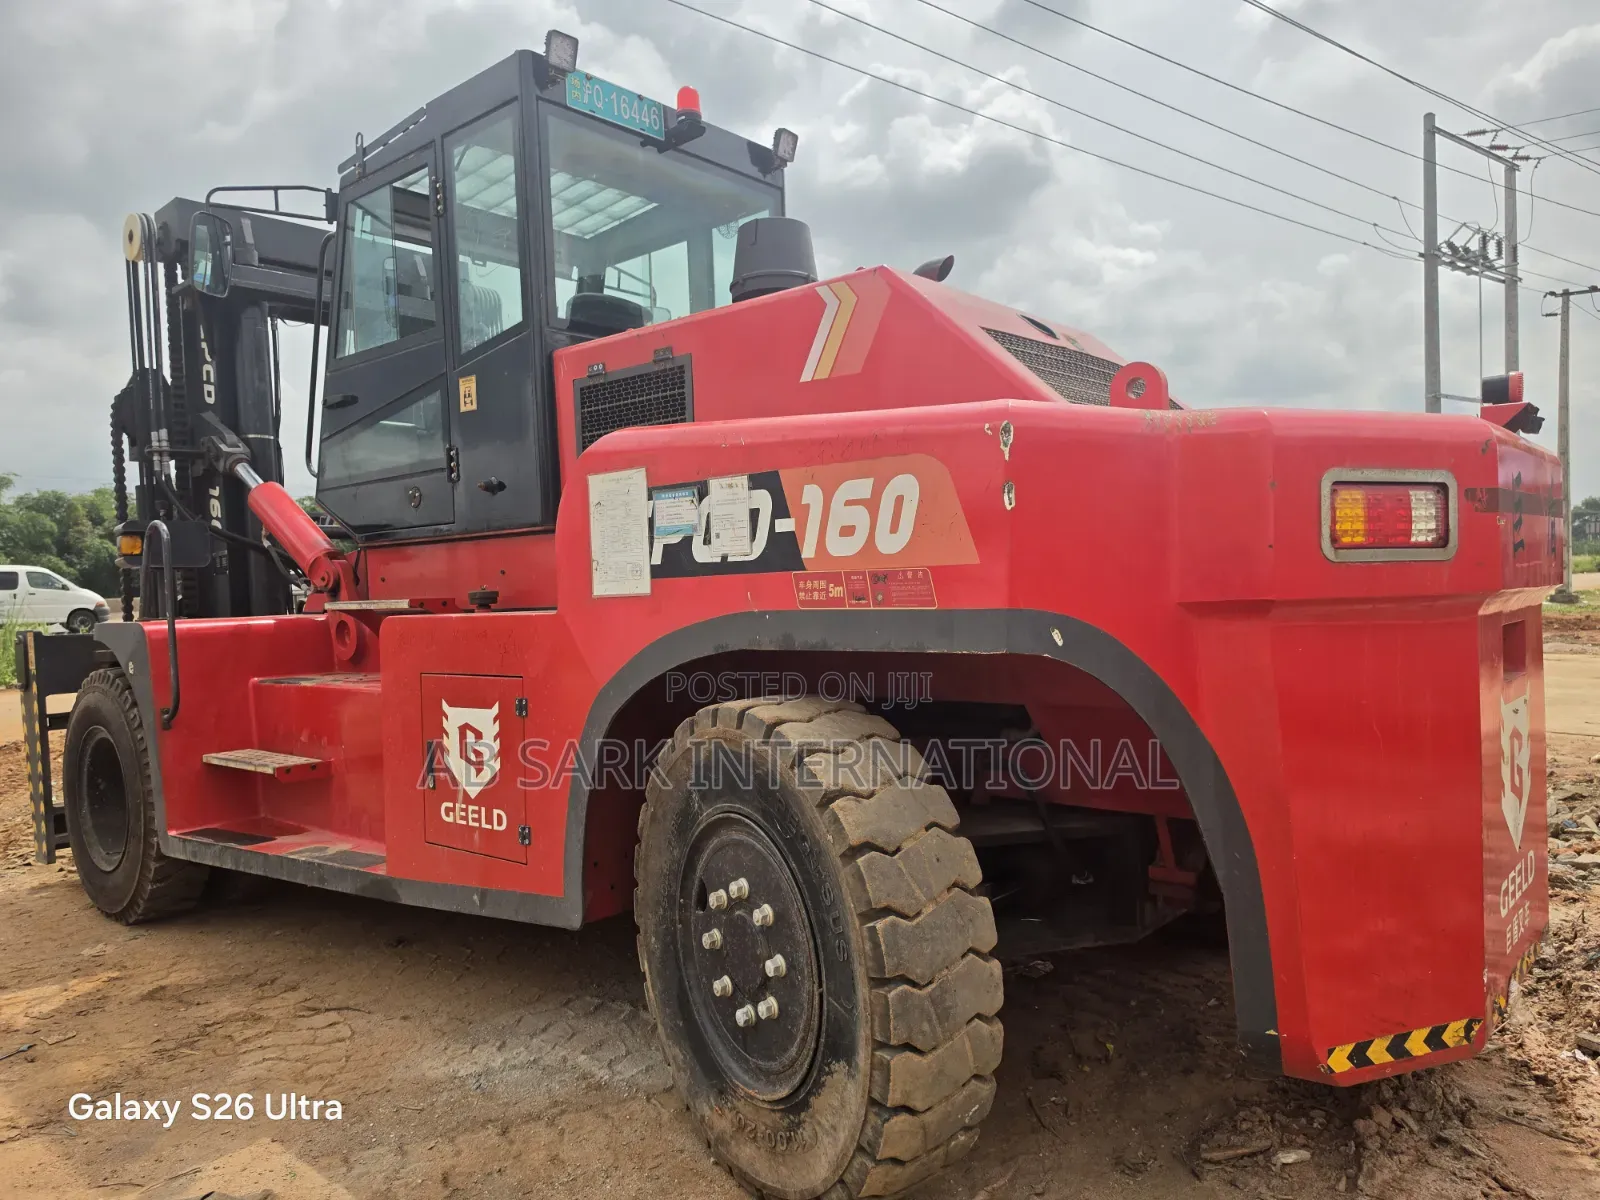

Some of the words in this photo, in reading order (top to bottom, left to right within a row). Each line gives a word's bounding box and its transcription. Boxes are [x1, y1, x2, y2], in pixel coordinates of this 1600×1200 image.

[829, 583, 843, 597] 5m
[441, 802, 507, 831] GEELD
[1500, 850, 1535, 918] GEELD
